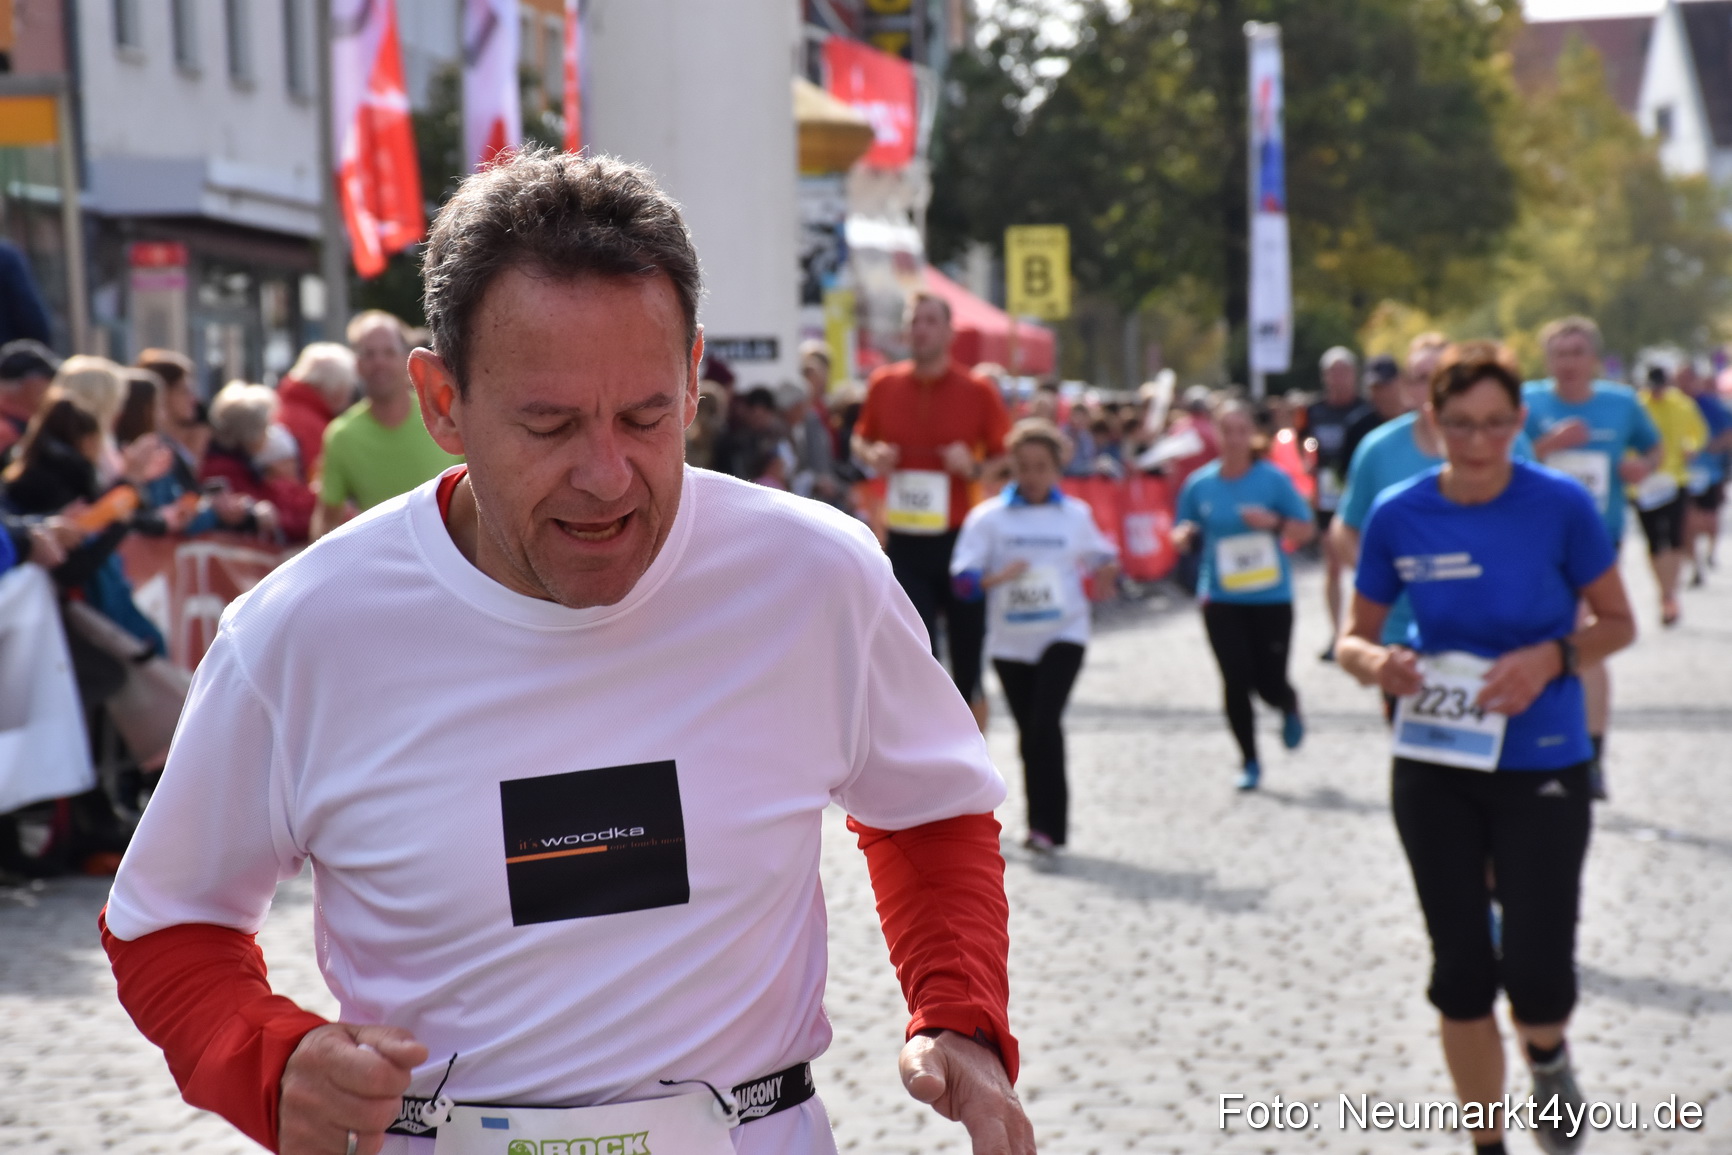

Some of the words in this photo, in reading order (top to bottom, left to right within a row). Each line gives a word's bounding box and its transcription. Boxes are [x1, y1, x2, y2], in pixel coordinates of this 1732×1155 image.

[1023, 254, 1054, 298] B
[541, 826, 645, 848] woodka
[733, 1075, 784, 1112] AUCONY
